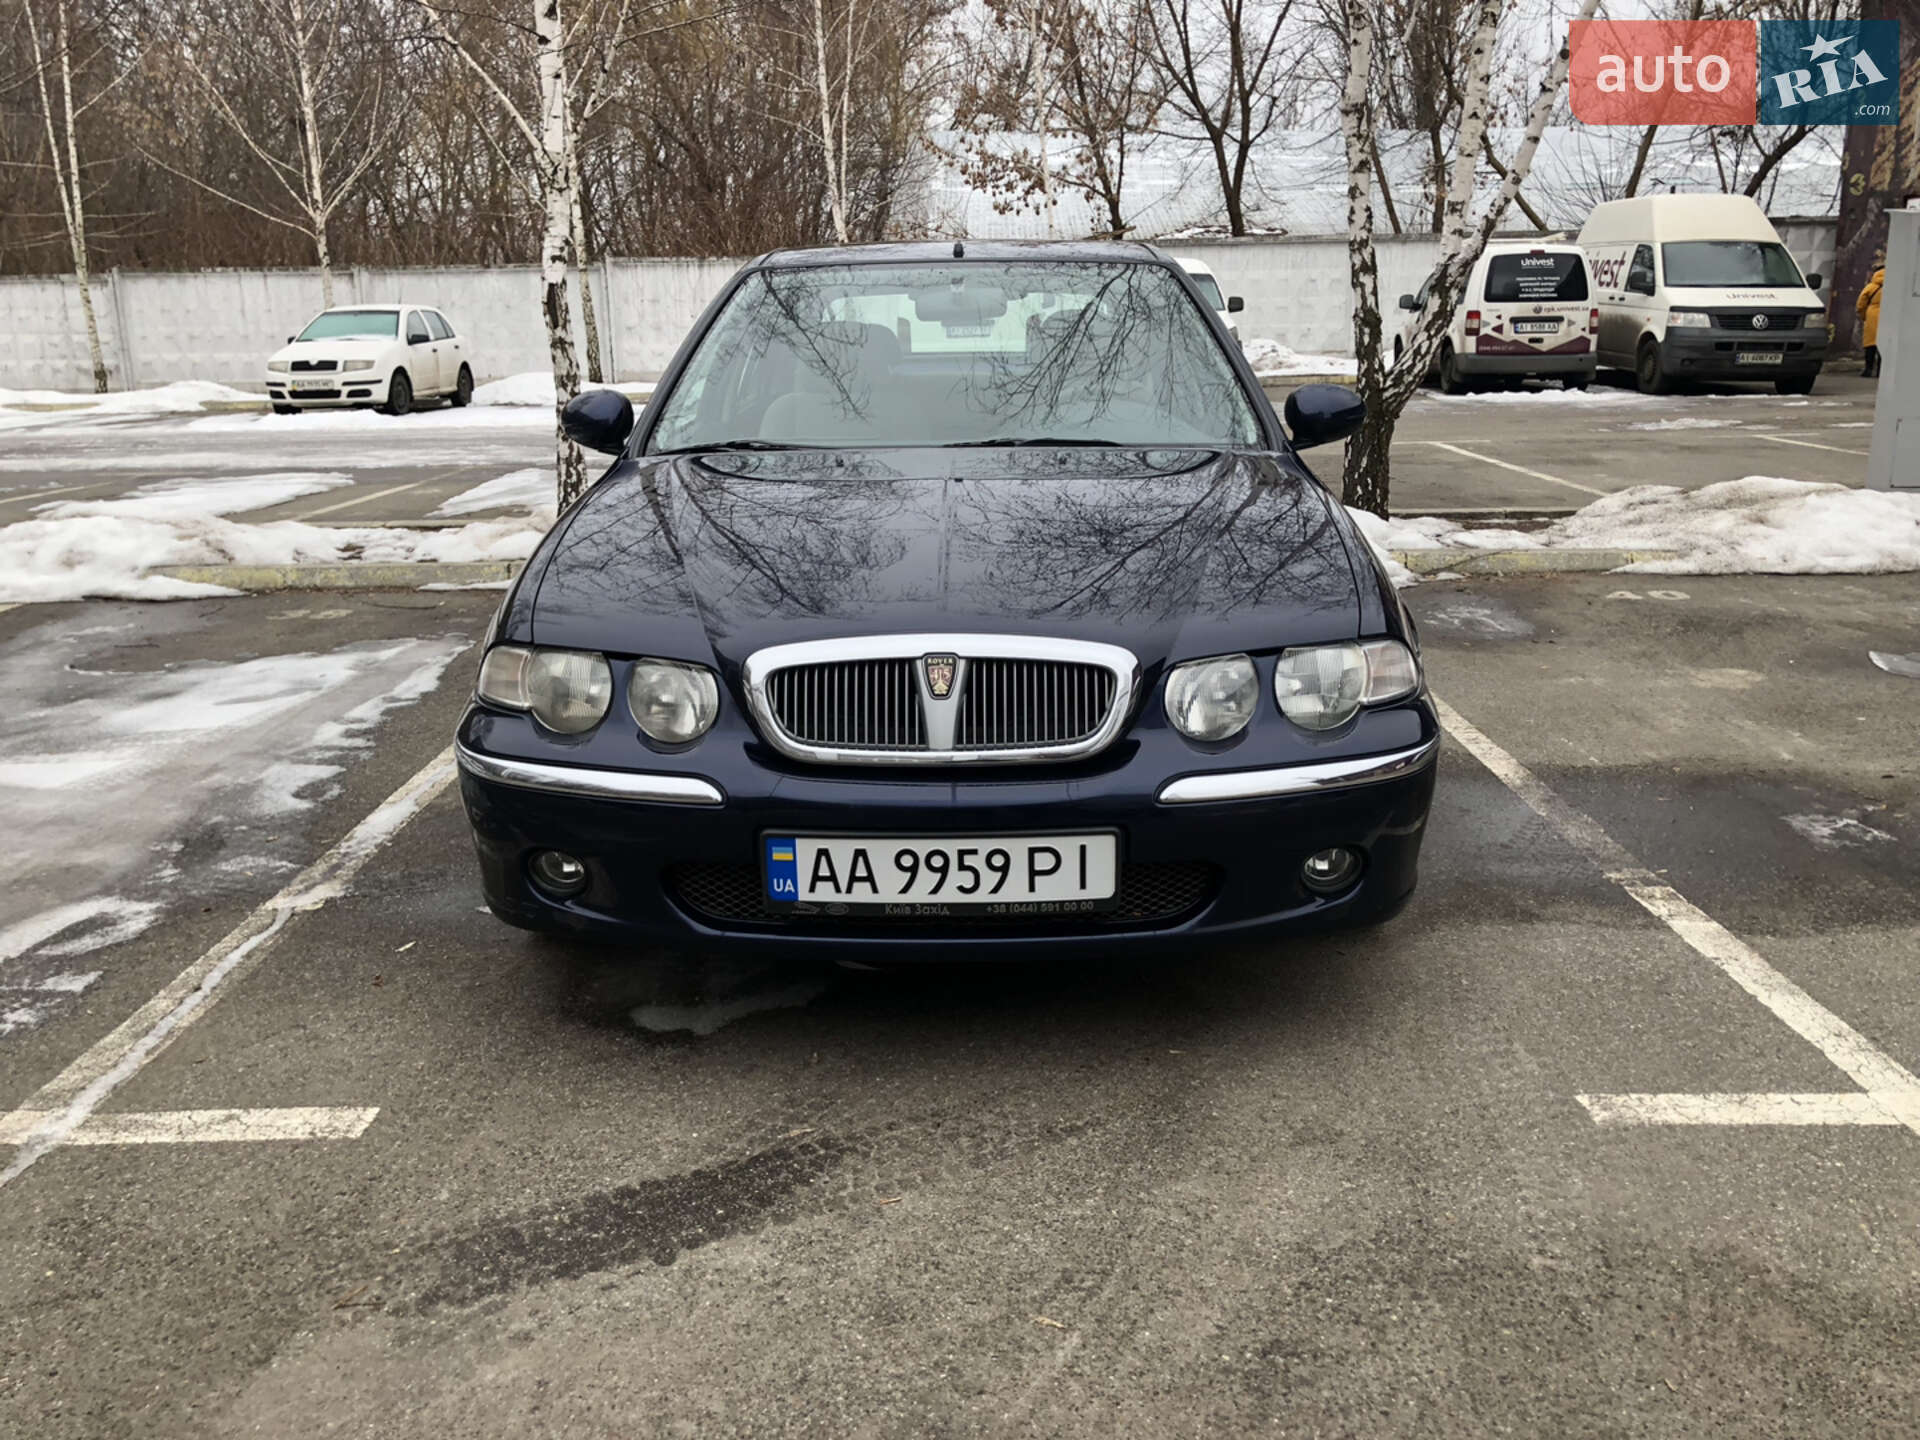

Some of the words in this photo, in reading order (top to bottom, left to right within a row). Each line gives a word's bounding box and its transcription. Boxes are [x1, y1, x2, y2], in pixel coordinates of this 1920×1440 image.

[808, 848, 879, 894] AA
[894, 848, 1011, 895] 9959
[773, 878, 795, 893] UA
[885, 904, 911, 915] Київ
[915, 904, 950, 915] Захід
[986, 904, 1006, 913] +38
[1009, 903, 1038, 913] (044)
[1064, 902, 1078, 911] 00
[1080, 901, 1094, 911] 00
